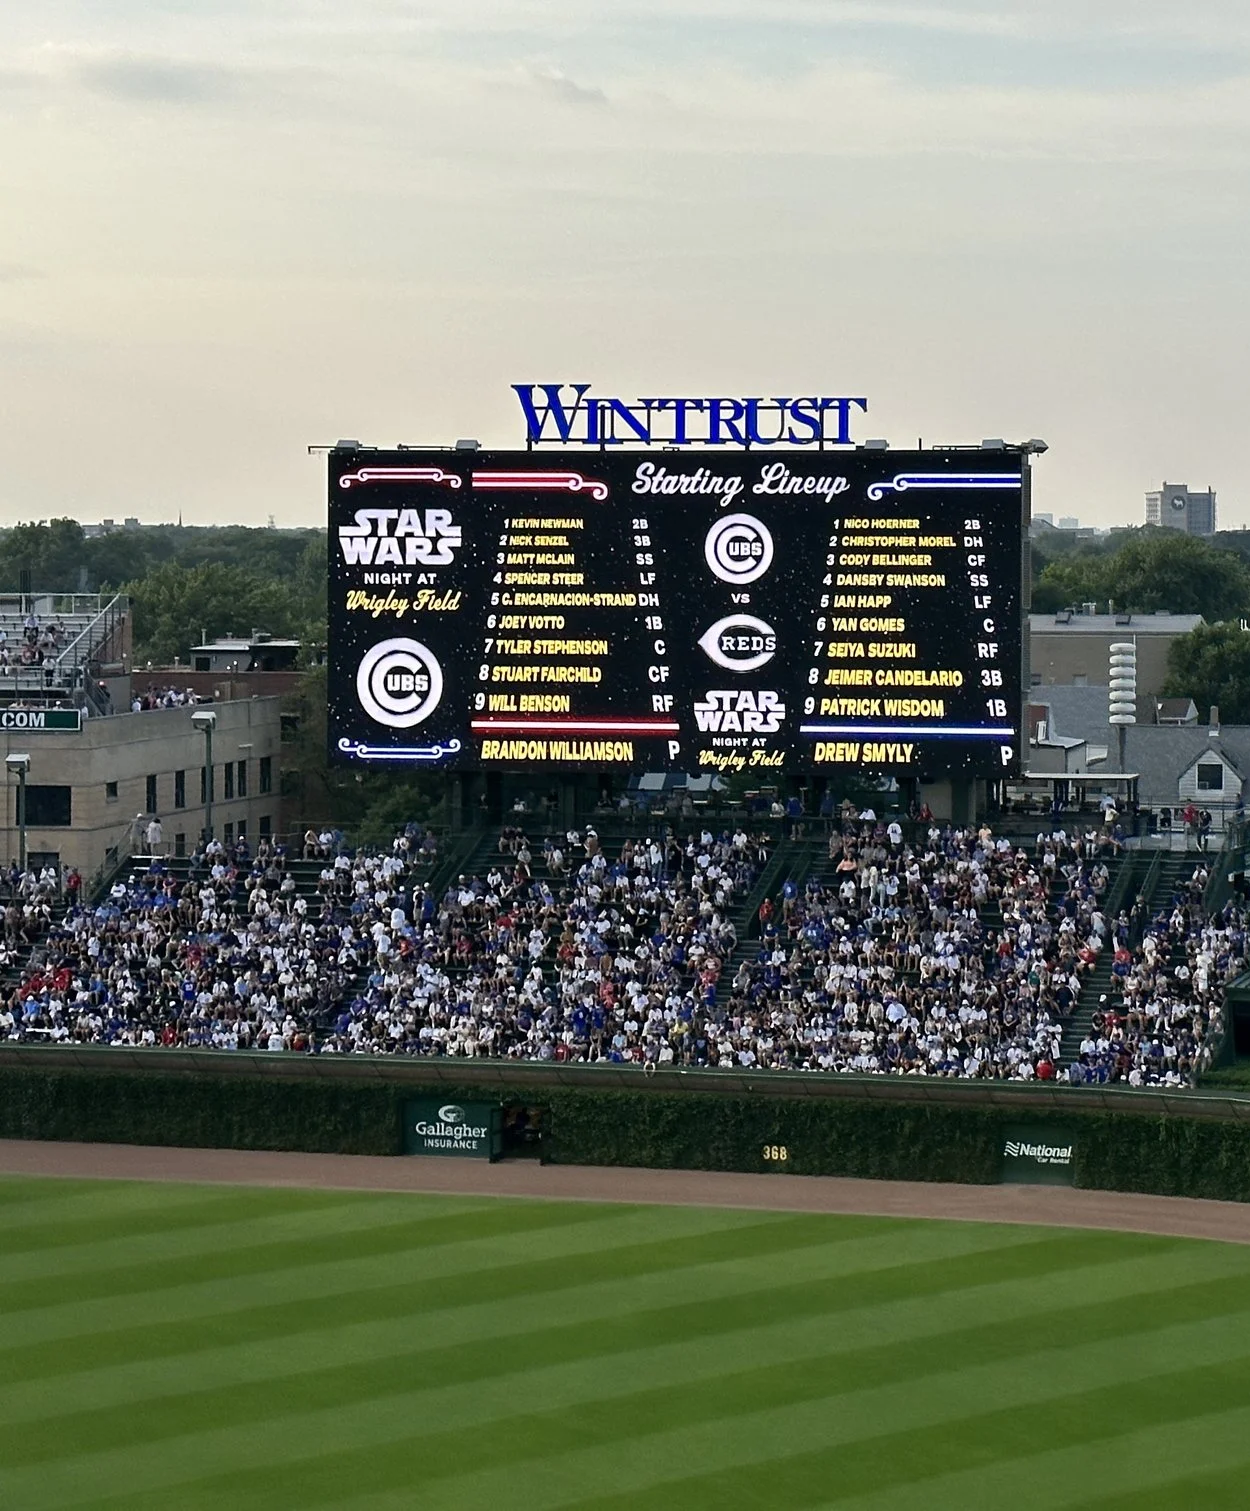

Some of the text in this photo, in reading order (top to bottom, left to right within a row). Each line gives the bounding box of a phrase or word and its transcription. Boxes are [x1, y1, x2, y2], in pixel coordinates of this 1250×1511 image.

[511, 384, 867, 444] WINTRUST
[631, 461, 849, 506] Starting Lineup
[339, 509, 462, 537] STAR
[504, 519, 648, 529] 1 KEVIN NEWMAN 2B
[834, 519, 980, 529] 1 NICO HOERNER 2B
[499, 535, 651, 546] 2 NICK SENZEL 3B
[829, 536, 983, 547] 2 CHRISTOPHER MOREL DH
[339, 537, 462, 565] WARS
[497, 553, 653, 565] 3 MATT MCLAIN SS
[827, 554, 985, 566] 3 CODY BELLINGER CF
[364, 573, 437, 584] NIGHT AT
[493, 572, 655, 585] 4 SPENCER STEER LF
[823, 574, 988, 588] 4 DANSBY SWANSON SS
[346, 590, 461, 618] Wrigley Field
[491, 593, 659, 607] 5 C. ENCARNACION-STRAND DH
[731, 593, 750, 603] VS
[821, 595, 991, 608] 5 IAN HAPP LF
[487, 615, 662, 629] 6 JOEY VOTTO 1B
[817, 617, 994, 634] 6 YAN GOMES C
[485, 639, 665, 655] 7 TYLER STEPHENSON C
[722, 636, 776, 651] REDS
[814, 642, 998, 658] 7 SEIYA SUZUKI RF
[479, 664, 669, 682] 8 STUART FAIRCHILD CF
[809, 668, 1002, 687] 8 JEIMER CANDELARIO 3B
[475, 693, 673, 712] 9 WILL BENSON RF
[694, 690, 785, 711] STAR
[804, 697, 1007, 719] 9 PATRICK WISDOM 1B
[694, 711, 785, 732] WARS
[713, 738, 766, 746] NIGHT AT
[481, 741, 680, 761] BRANDON WILLIAMSON P
[814, 743, 1012, 765] DREW SMYLY P
[699, 750, 785, 770] Wrigley Field
[416, 1121, 487, 1140] Gallagher
[424, 1139, 478, 1150] INSURANCE
[1020, 1144, 1072, 1157] National
[763, 1145, 787, 1160] 368
